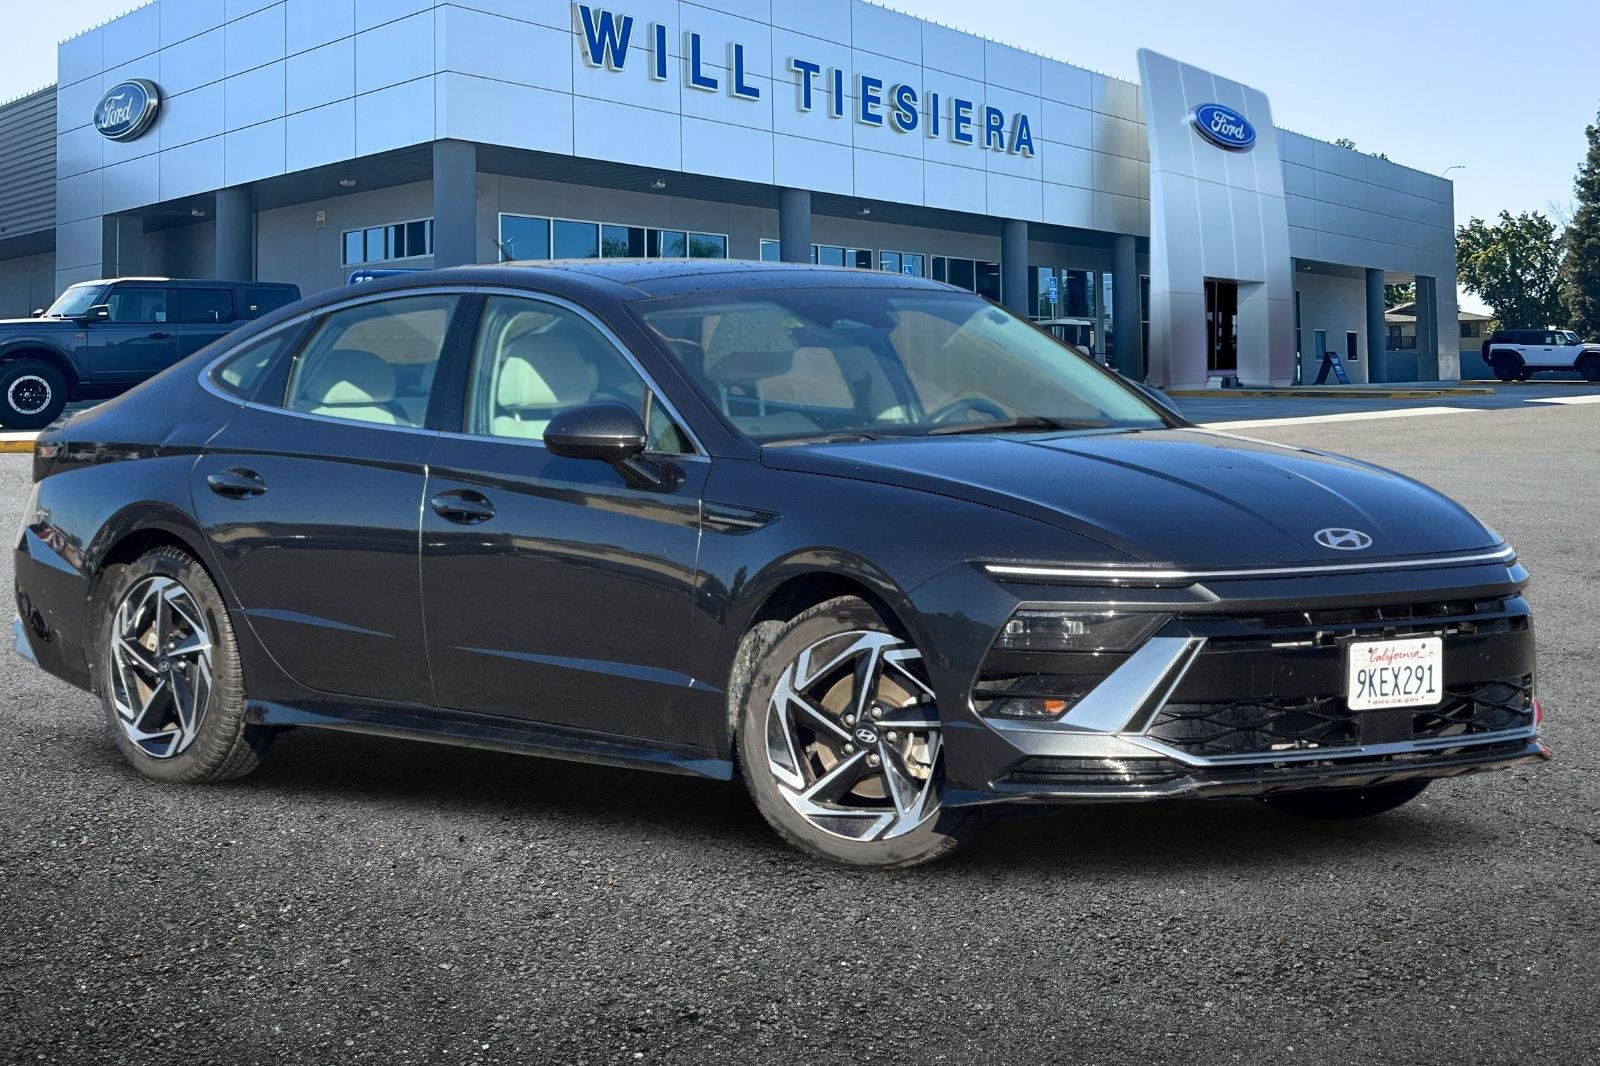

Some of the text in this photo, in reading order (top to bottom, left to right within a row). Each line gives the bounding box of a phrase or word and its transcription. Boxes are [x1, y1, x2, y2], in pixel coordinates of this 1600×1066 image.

[576, 3, 1035, 157] WILL TIESIERA
[101, 93, 133, 128] Ford
[1211, 111, 1244, 139] Ford
[1369, 647, 1426, 665] California
[1356, 664, 1435, 699] 9KEX291
